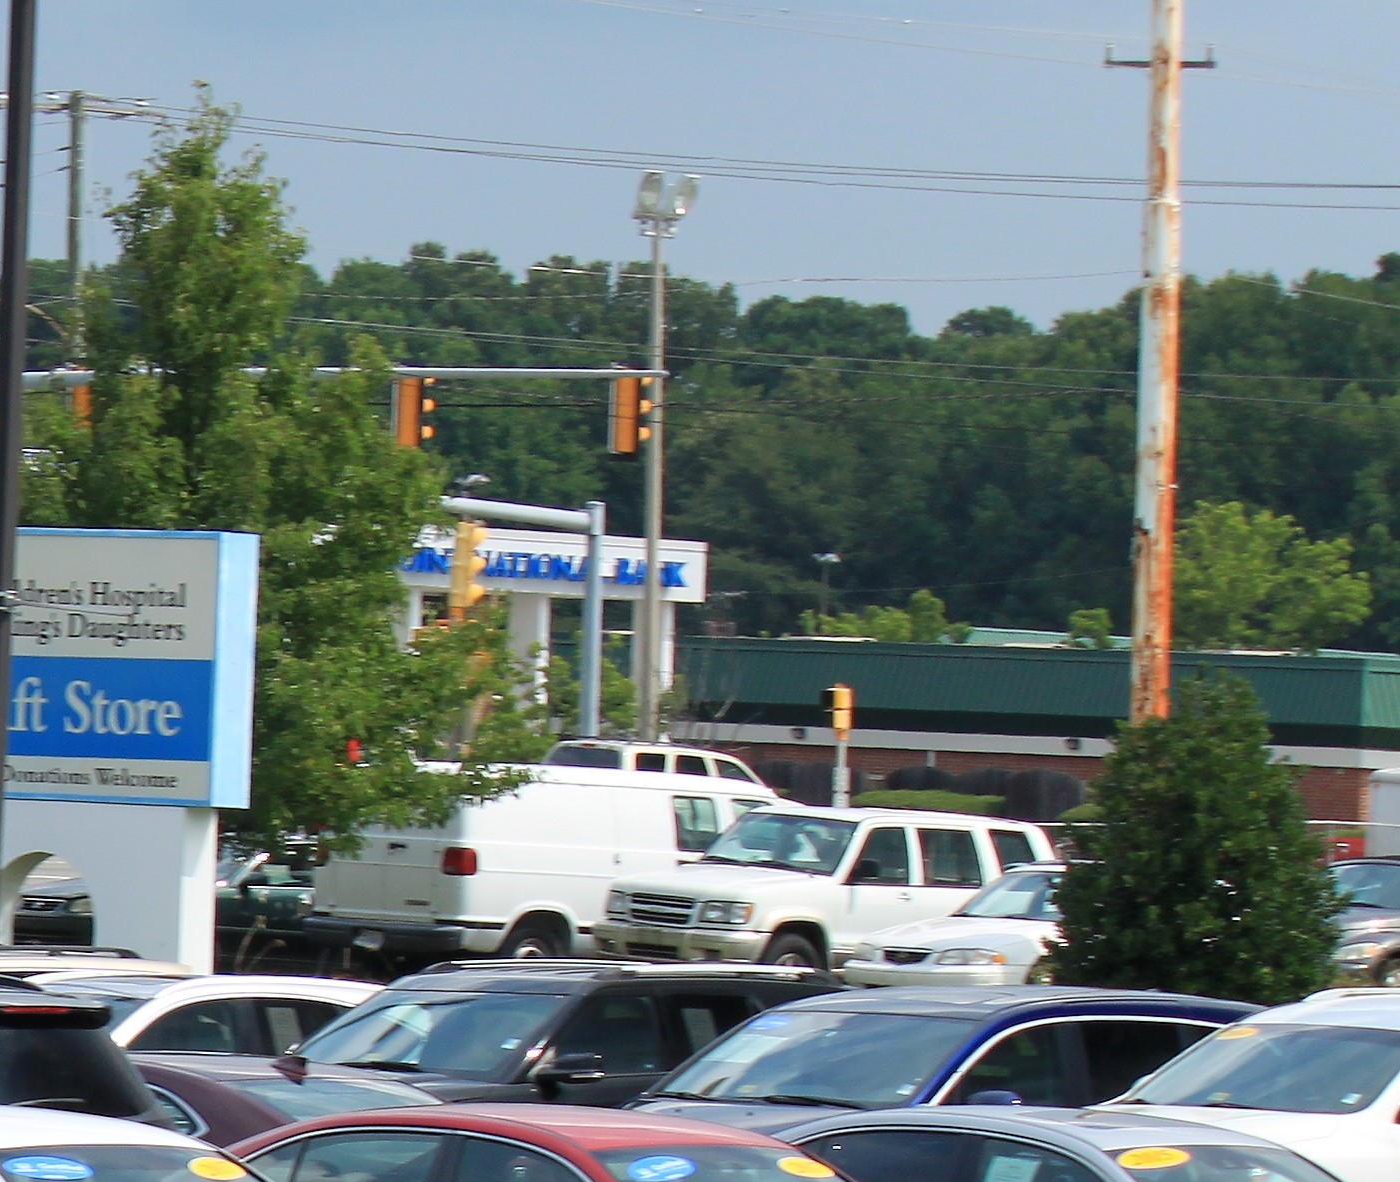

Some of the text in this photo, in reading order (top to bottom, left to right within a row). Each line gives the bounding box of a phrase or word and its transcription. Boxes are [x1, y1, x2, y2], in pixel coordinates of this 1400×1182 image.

[615, 557, 688, 588] BAK
[88, 580, 187, 614] Hospital
[9, 612, 61, 645] ing's
[66, 612, 187, 647] Daughters
[63, 680, 185, 738] Store
[93, 767, 180, 788] Welcome
